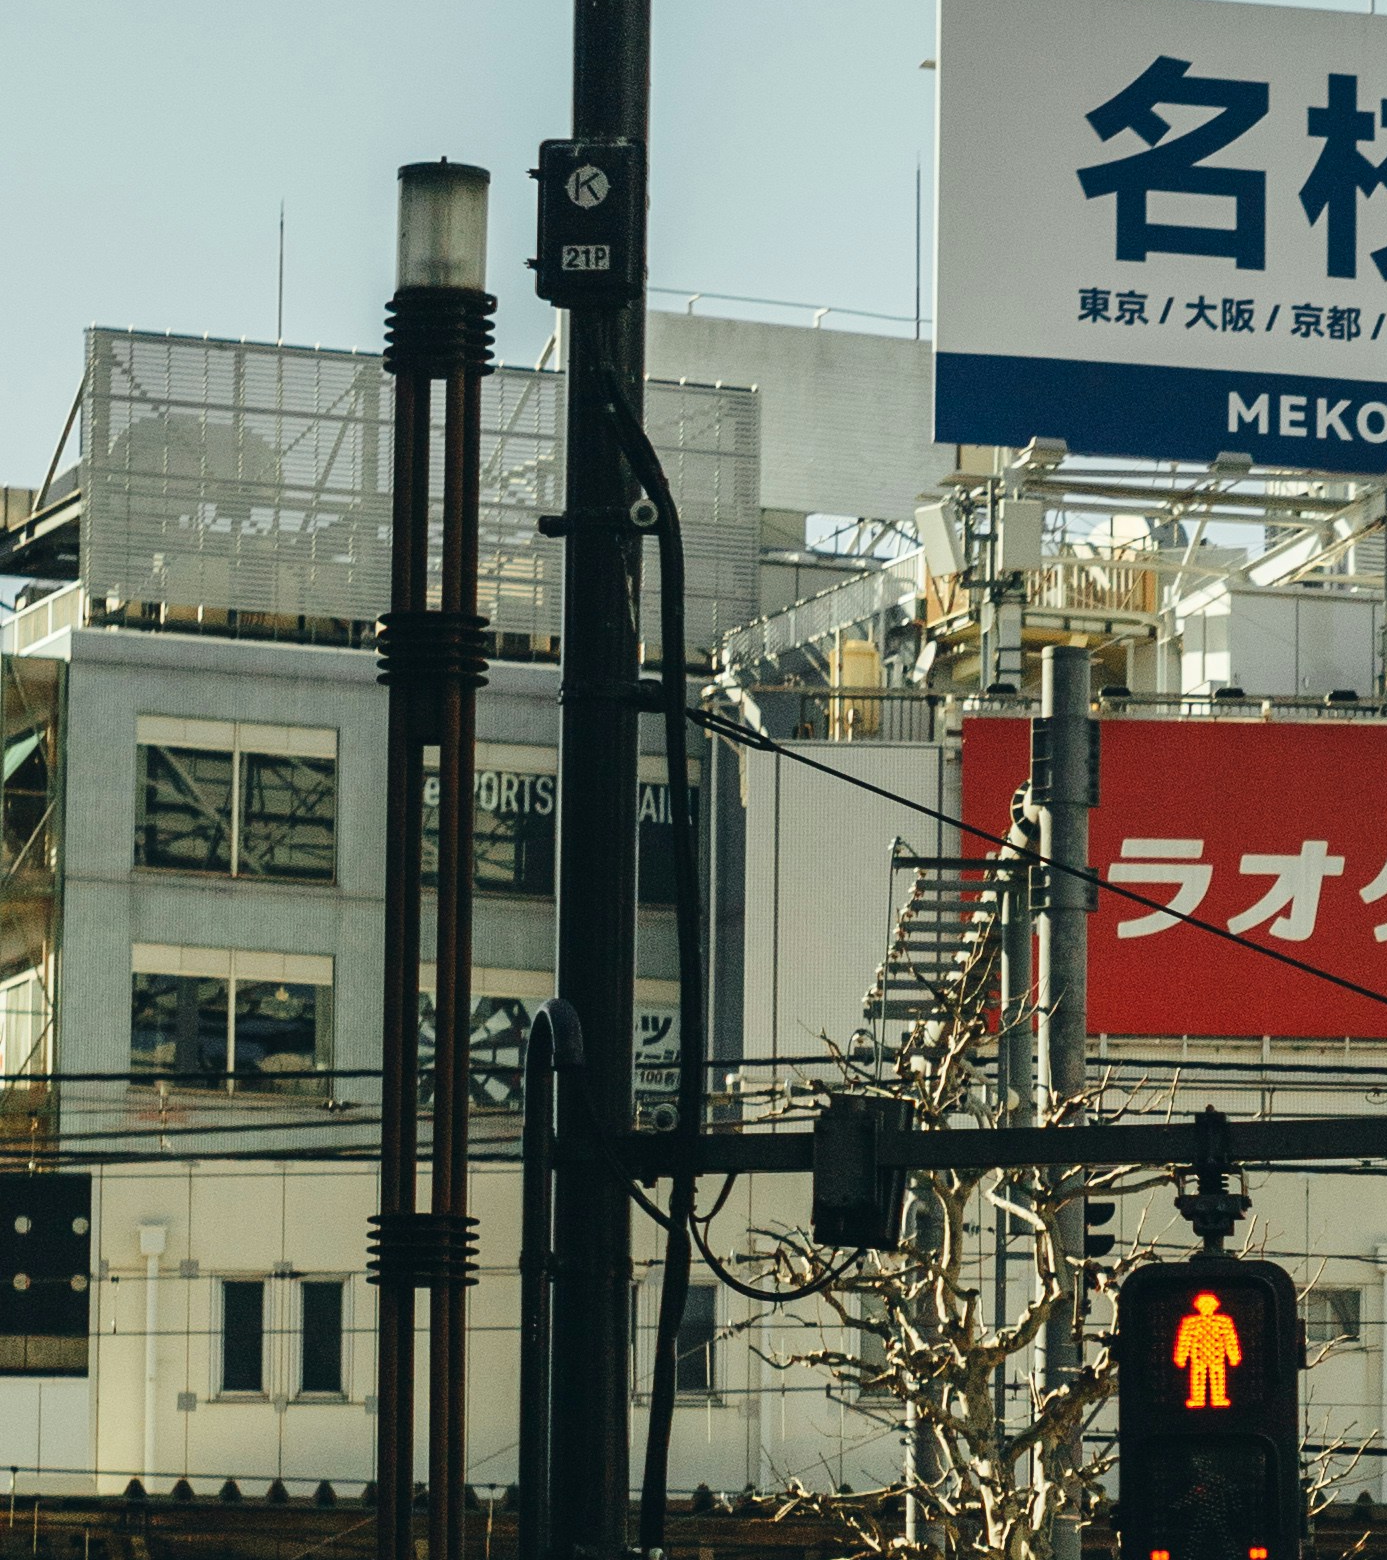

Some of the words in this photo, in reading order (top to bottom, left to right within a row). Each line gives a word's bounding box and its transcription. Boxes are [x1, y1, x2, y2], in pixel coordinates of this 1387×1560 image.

[566, 248, 607, 268] 21P
[1077, 288, 1148, 325] 東京
[1185, 296, 1255, 334] 大阪
[1291, 304, 1361, 341] 京都
